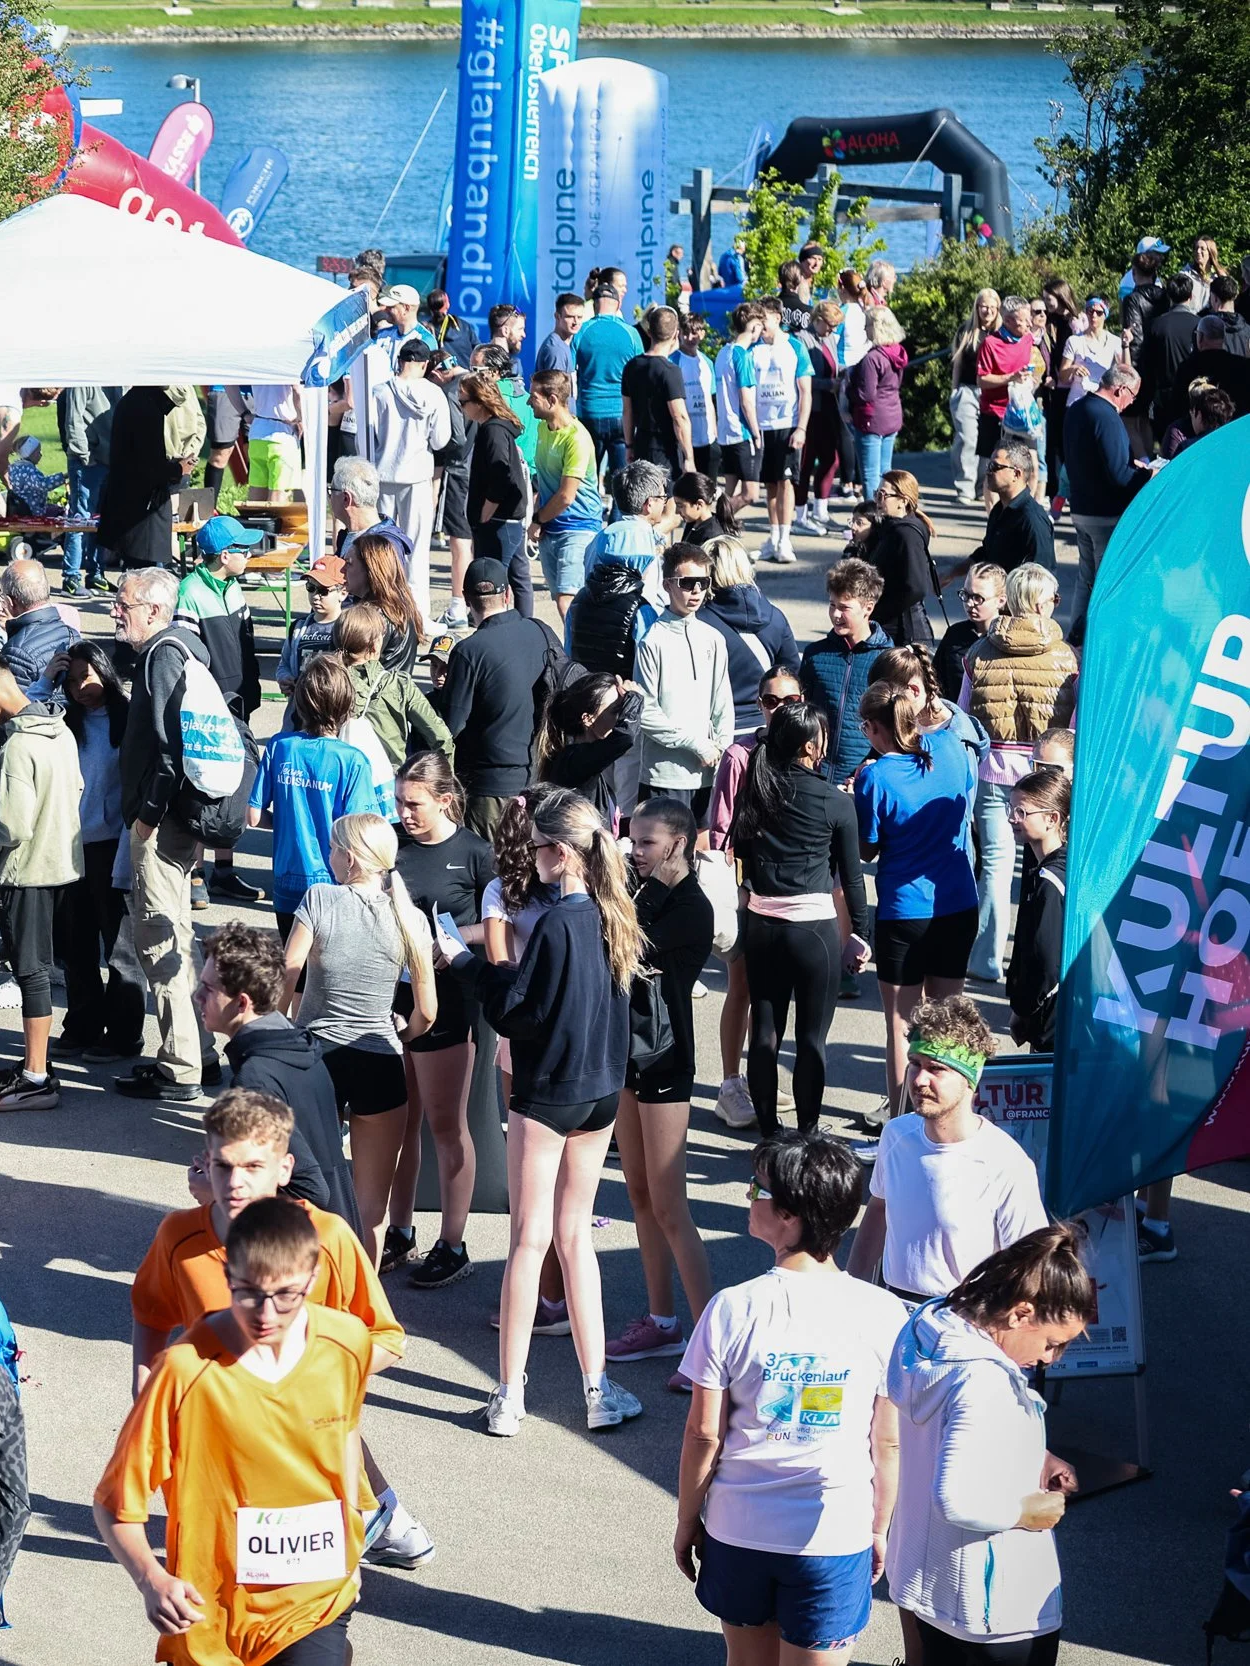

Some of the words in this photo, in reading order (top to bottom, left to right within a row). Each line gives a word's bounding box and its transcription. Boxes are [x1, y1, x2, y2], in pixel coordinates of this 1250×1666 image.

[848, 131, 900, 149] ALOHA
[459, 16, 504, 322] #glaubandic
[548, 168, 582, 295] talpine
[760, 391, 785, 399] JULIAN
[279, 761, 304, 777] Team
[276, 774, 333, 793] ALOISIANUM
[974, 1083, 1044, 1107] LTUR
[1006, 1109, 1050, 1119] @FRANC
[765, 1353, 777, 1367] 3
[762, 1367, 851, 1383] Brückenlauf
[248, 1531, 335, 1555] OLIVIER
